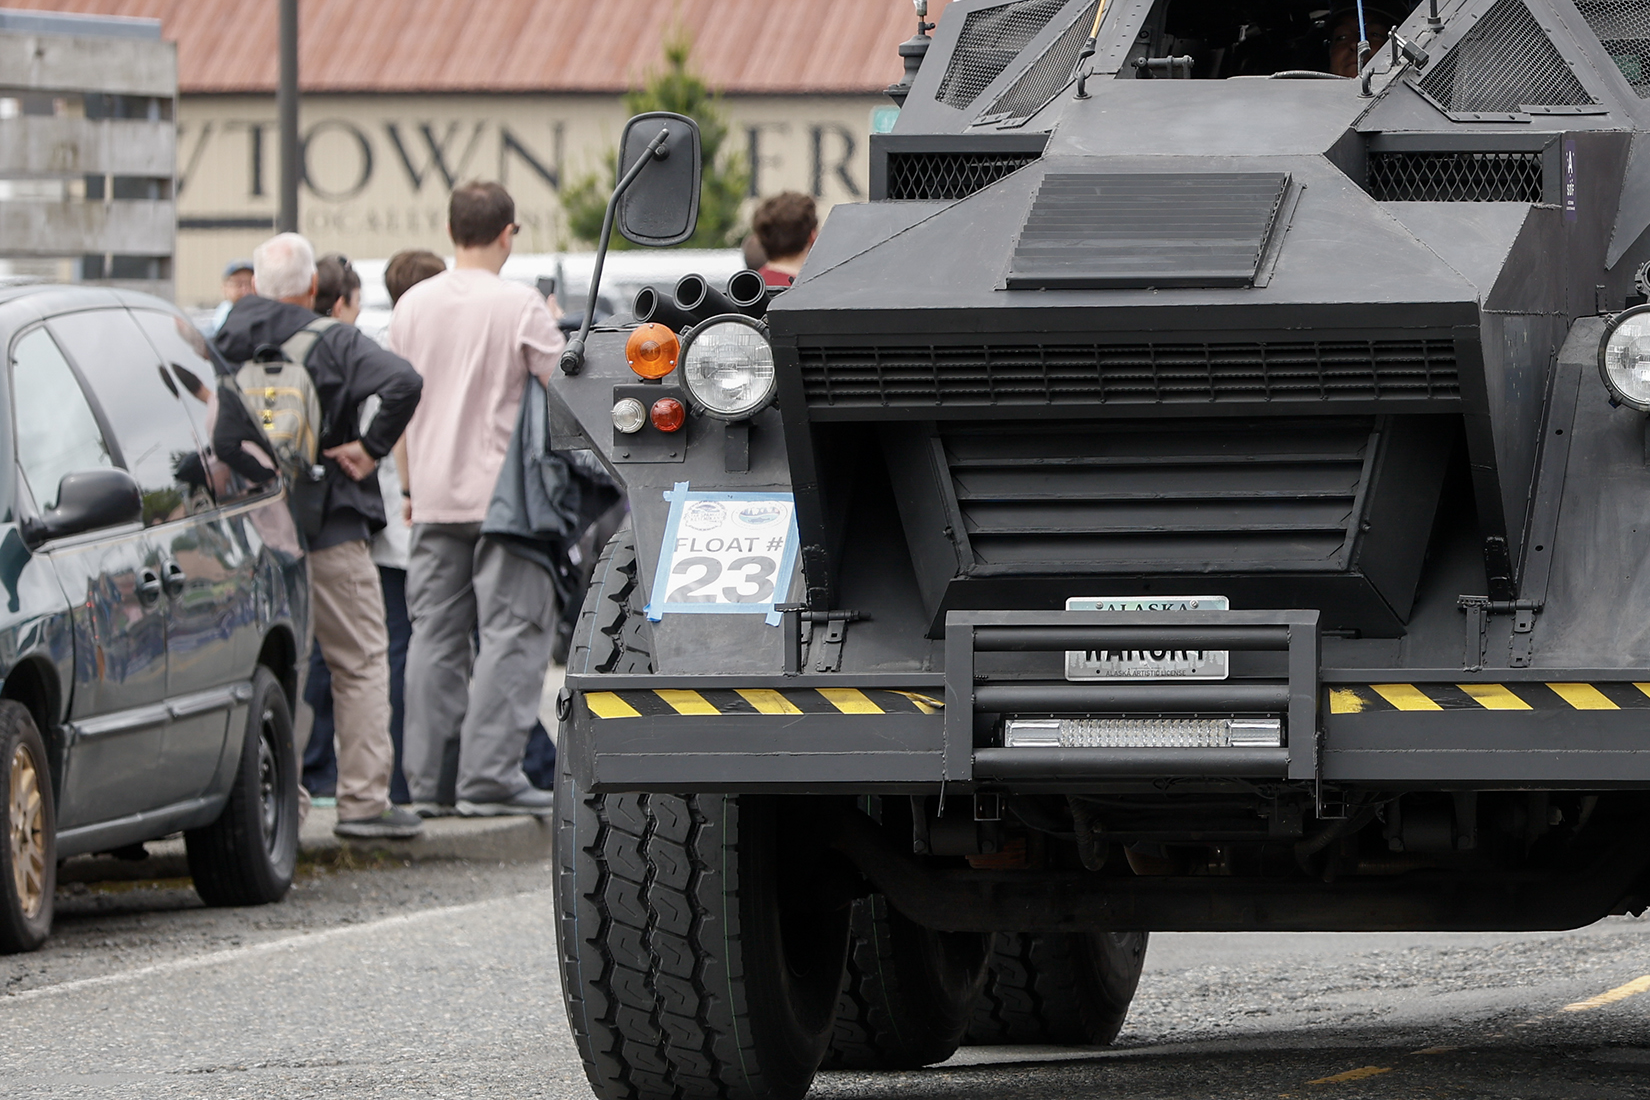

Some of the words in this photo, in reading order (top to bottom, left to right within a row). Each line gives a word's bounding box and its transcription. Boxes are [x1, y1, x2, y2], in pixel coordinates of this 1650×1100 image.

[674, 537, 760, 553] FLOAT
[766, 536, 784, 552] #
[666, 555, 777, 603] 23
